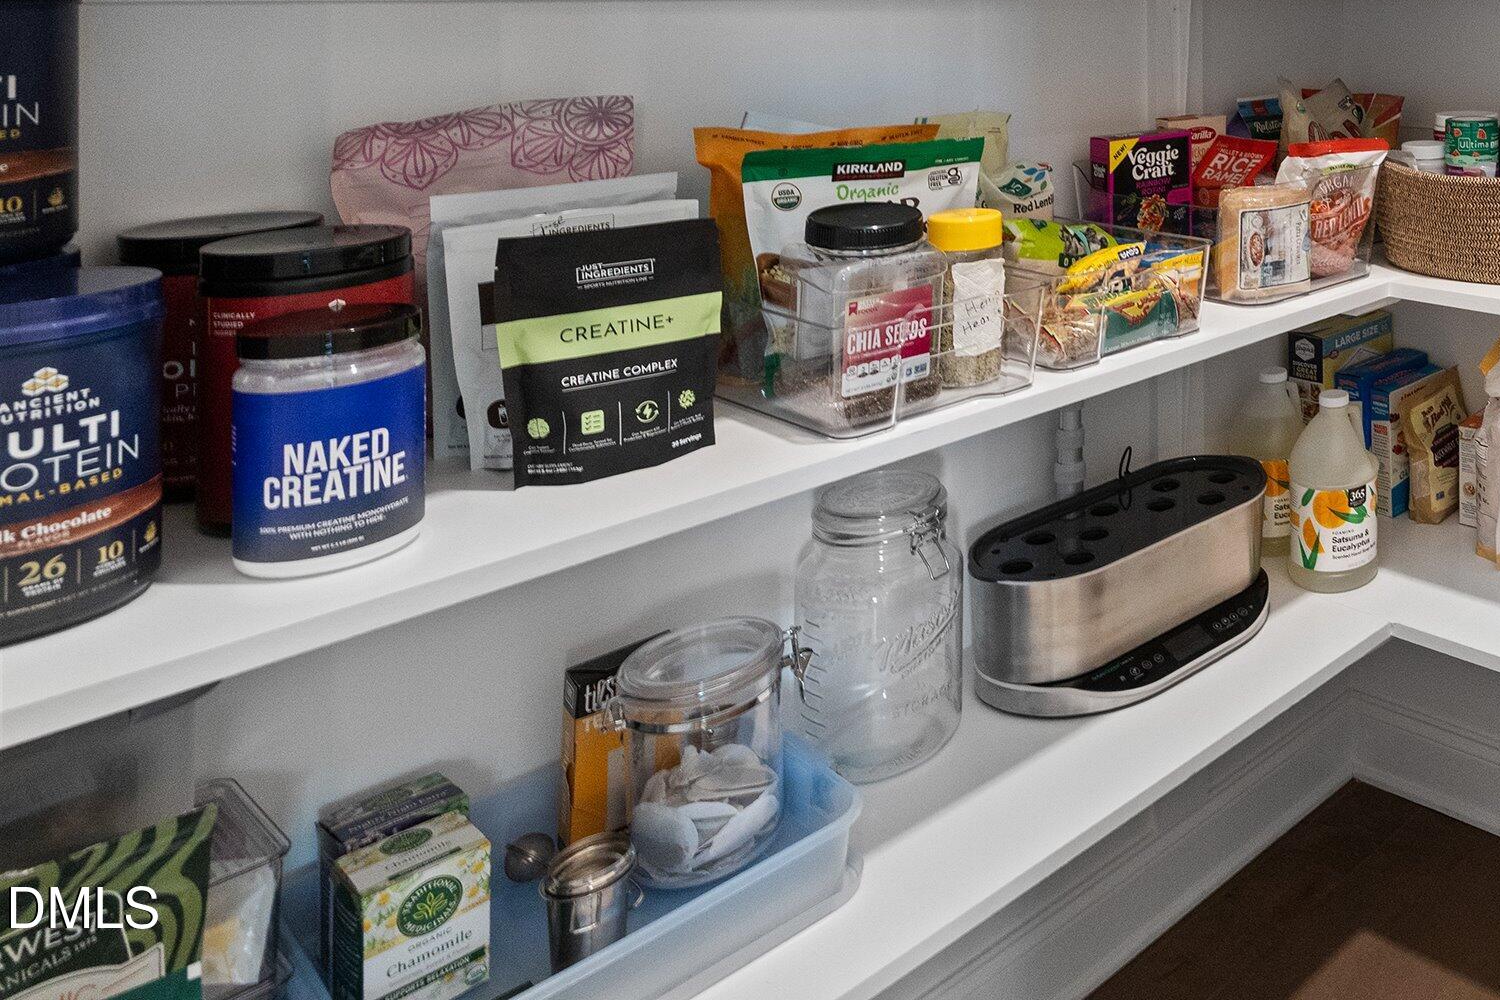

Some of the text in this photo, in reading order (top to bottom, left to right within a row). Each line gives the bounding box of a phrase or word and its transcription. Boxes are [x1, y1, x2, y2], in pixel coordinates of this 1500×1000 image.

[1113, 143, 1128, 161] NEW!
[1459, 138, 1492, 151] Ultima
[1127, 144, 1179, 167] Veggie
[1209, 154, 1263, 175] RICE
[836, 161, 903, 174] KIRKLAND
[929, 173, 949, 182] GLUTEN
[1131, 161, 1174, 181] Craft
[777, 189, 795, 197] USDA
[836, 184, 900, 203] Organic
[1013, 202, 1034, 214] Red
[548, 221, 610, 236] INGREDIENTS
[581, 262, 603, 272] JUST
[581, 263, 650, 280] INGREDIENTS
[212, 311, 256, 321] CLINICALLY
[559, 313, 674, 344] CREATINE+
[1334, 324, 1379, 348] LARGE SIZE
[847, 327, 881, 355] CHIA
[561, 358, 678, 388] CREATINE COMPLEX
[283, 427, 390, 476] NAKED
[263, 451, 406, 510] CREATINE
[1350, 488, 1365, 501] 365
[21, 506, 113, 541] Chocolate
[277, 496, 409, 534] PREMIUM CREATINE MONOHYDRATE
[289, 532, 312, 541] WITH
[313, 523, 353, 538] NOTHING
[354, 520, 365, 528] TO
[1332, 528, 1369, 544] Satsuma &
[97, 540, 125, 563] 10
[1332, 538, 1371, 553] Eucalyptus
[18, 555, 67, 587] 26
[386, 928, 473, 978] Chamomile
